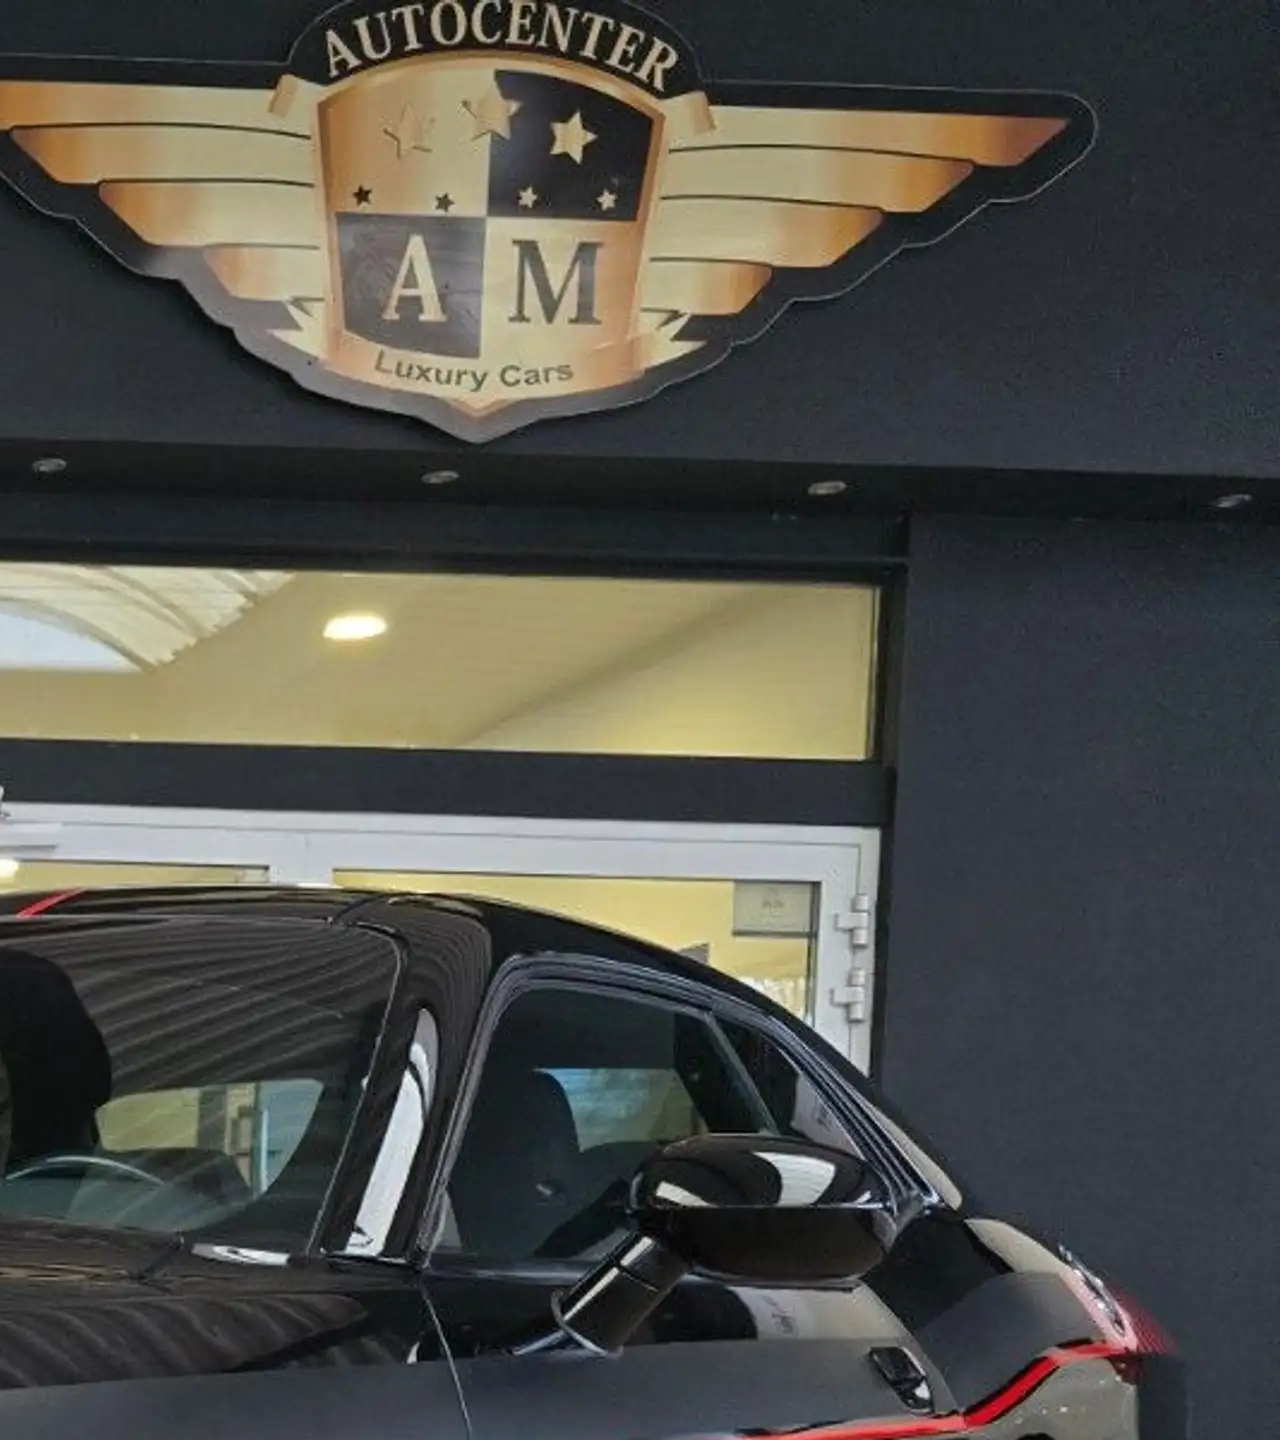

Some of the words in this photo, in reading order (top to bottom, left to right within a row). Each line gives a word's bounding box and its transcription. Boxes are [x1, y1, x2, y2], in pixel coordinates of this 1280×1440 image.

[324, 0, 680, 92] AUTOCENTER
[382, 233, 447, 322] A
[508, 239, 604, 325] M
[374, 349, 488, 393] Luxury
[499, 364, 575, 387] Cars
